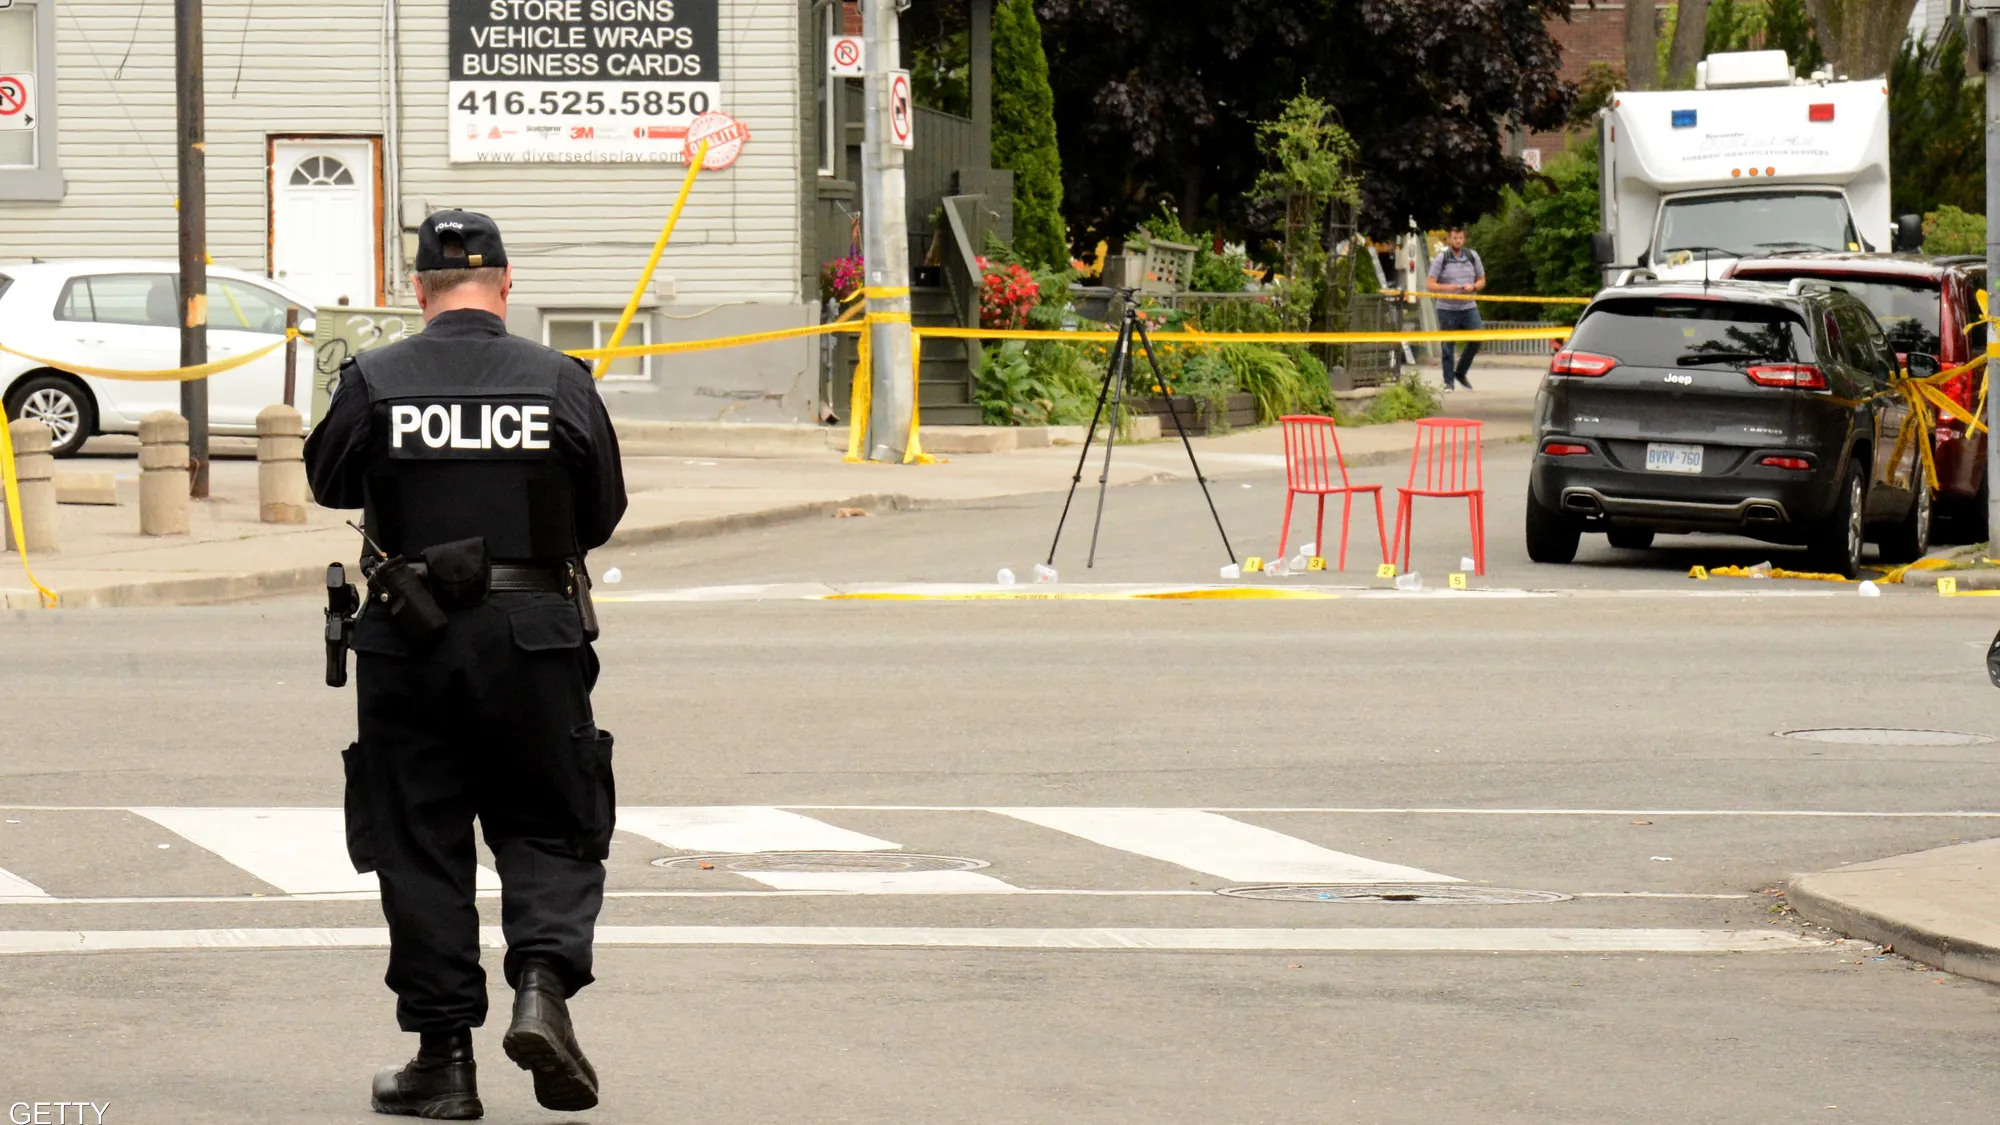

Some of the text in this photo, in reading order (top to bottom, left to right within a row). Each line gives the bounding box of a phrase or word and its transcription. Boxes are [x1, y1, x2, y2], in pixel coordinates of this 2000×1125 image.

[489, 0, 675, 22] STORE SIGNS
[470, 26, 693, 49] VEHICLE WRAPS
[462, 53, 701, 76] BUSINESS CARDS
[457, 90, 710, 116] 416.525.5850
[570, 126, 594, 140] 3M
[434, 221, 464, 233] POLICE
[1663, 372, 1693, 386] Jeep
[391, 403, 551, 450] POLICE
